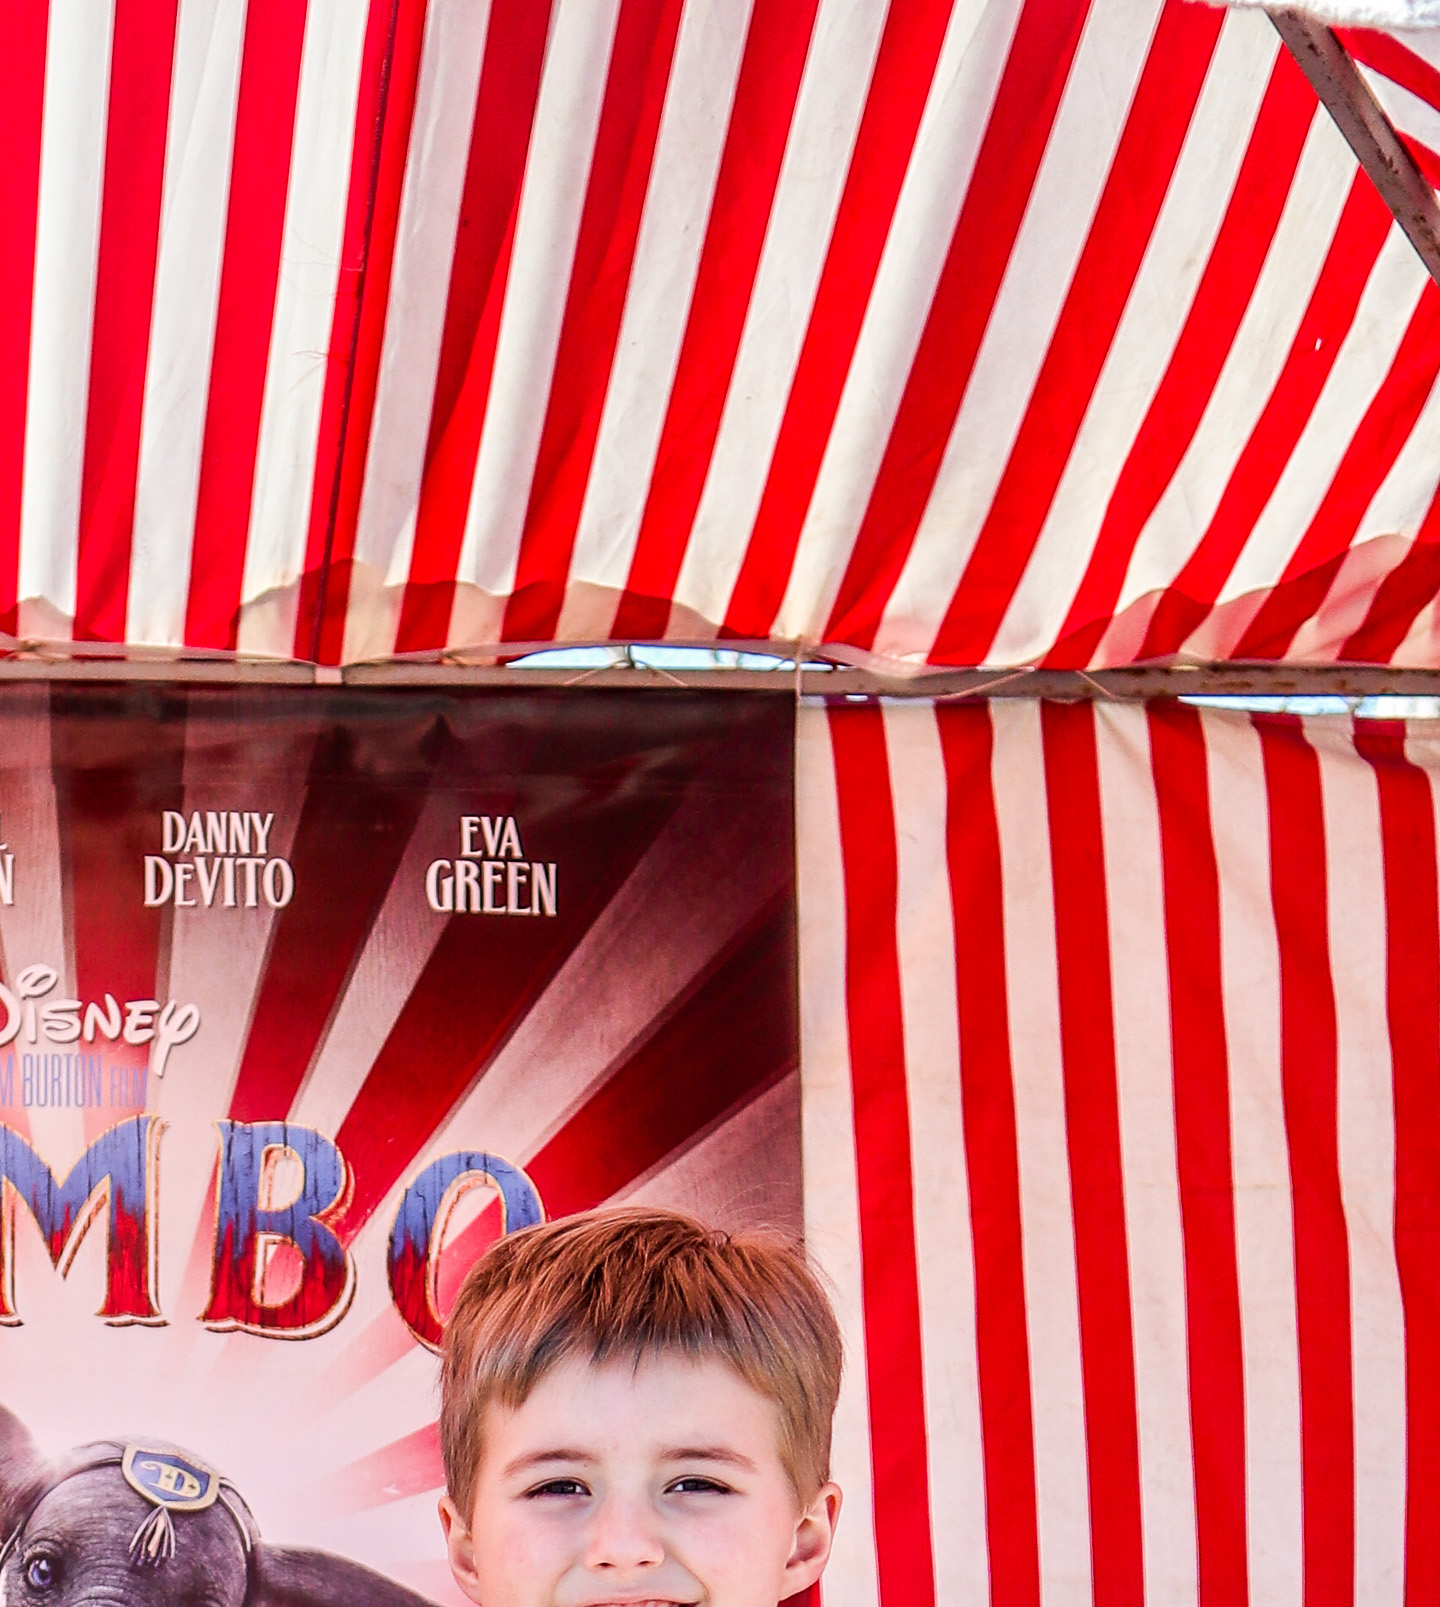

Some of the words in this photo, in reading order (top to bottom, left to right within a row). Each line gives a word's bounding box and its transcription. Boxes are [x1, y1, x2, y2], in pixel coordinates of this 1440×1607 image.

[162, 811, 274, 854] DANNY
[460, 816, 523, 858] EVA
[143, 855, 295, 908] DeVITO
[425, 860, 558, 917] GREEN
[22, 1053, 103, 1107] BURTON
[110, 1066, 148, 1108] FILM
